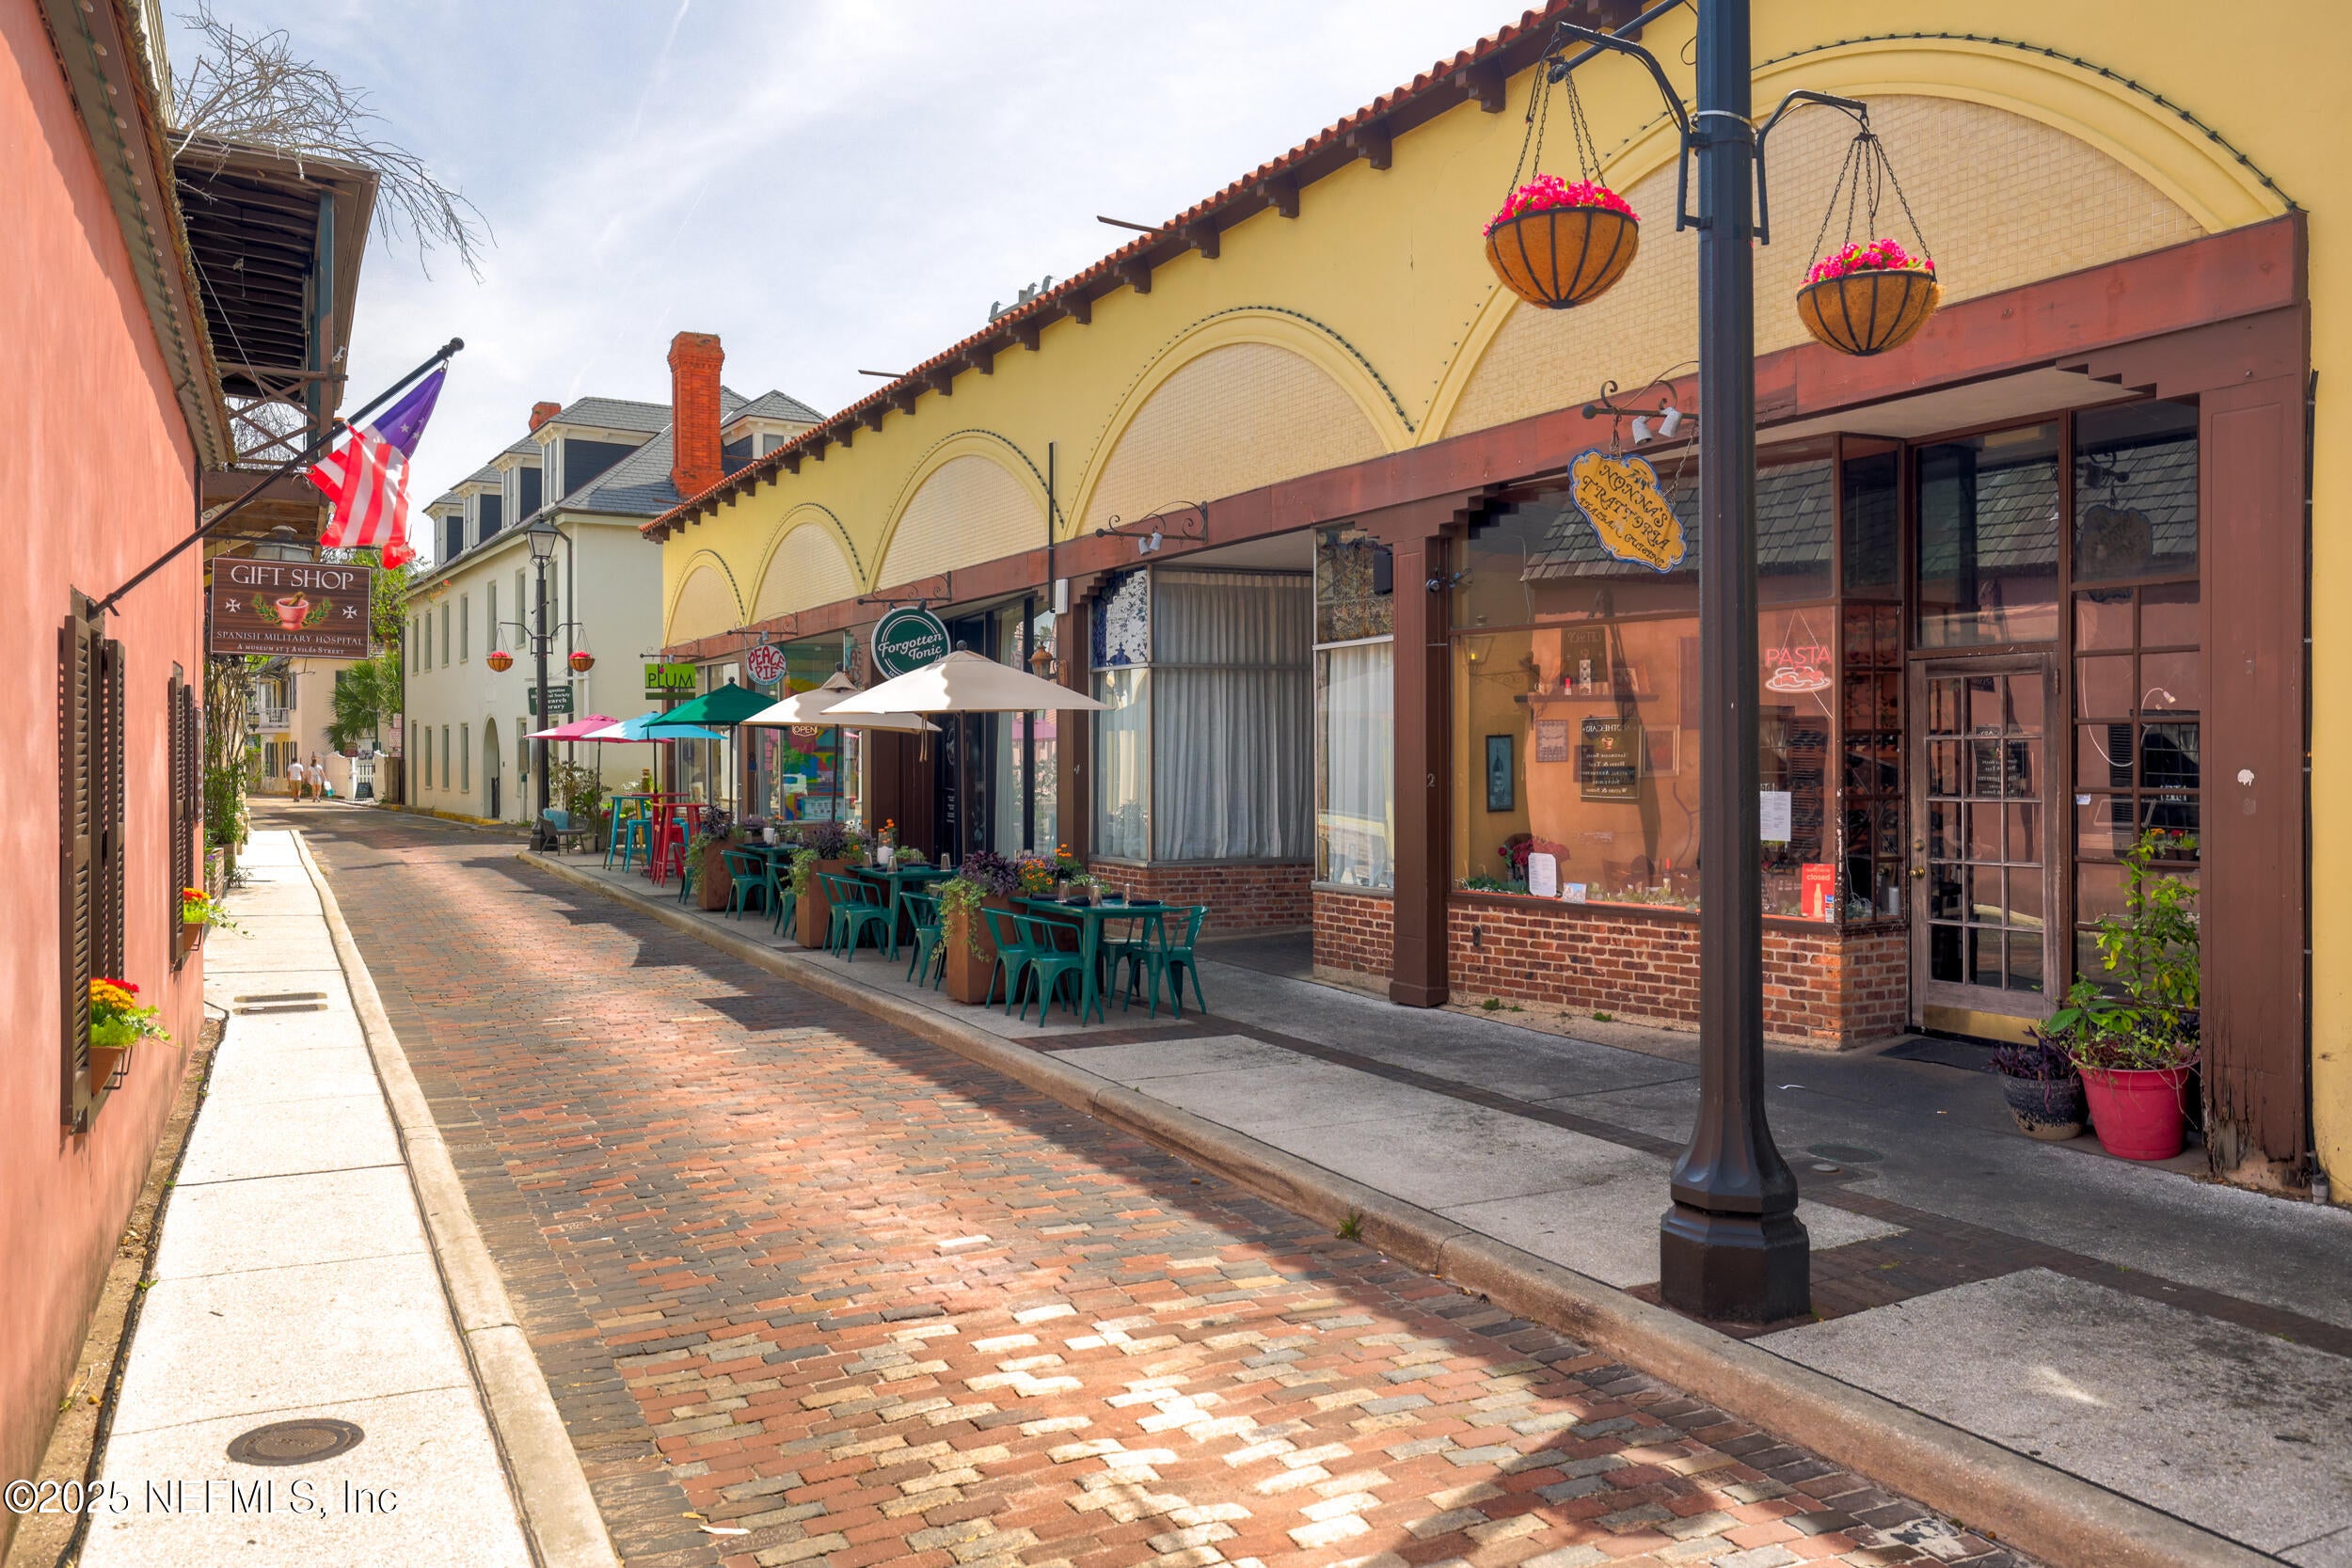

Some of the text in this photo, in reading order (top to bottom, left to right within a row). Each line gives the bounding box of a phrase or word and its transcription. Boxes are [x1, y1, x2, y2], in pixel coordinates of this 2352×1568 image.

[1599, 466, 1668, 528] NONNA'S
[1582, 475, 1671, 550] TRATTORIA
[230, 565, 354, 590] GIFT SHOP
[216, 631, 364, 645] SPANISH MILITARY HOSPITAL
[878, 633, 944, 657] Forgotten
[748, 645, 786, 672] PEACE
[908, 644, 943, 660] Tonic
[1765, 645, 1832, 668] PASTA
[648, 664, 693, 688] PLUM
[755, 665, 779, 679] PIE
[795, 725, 818, 734] OPEN
